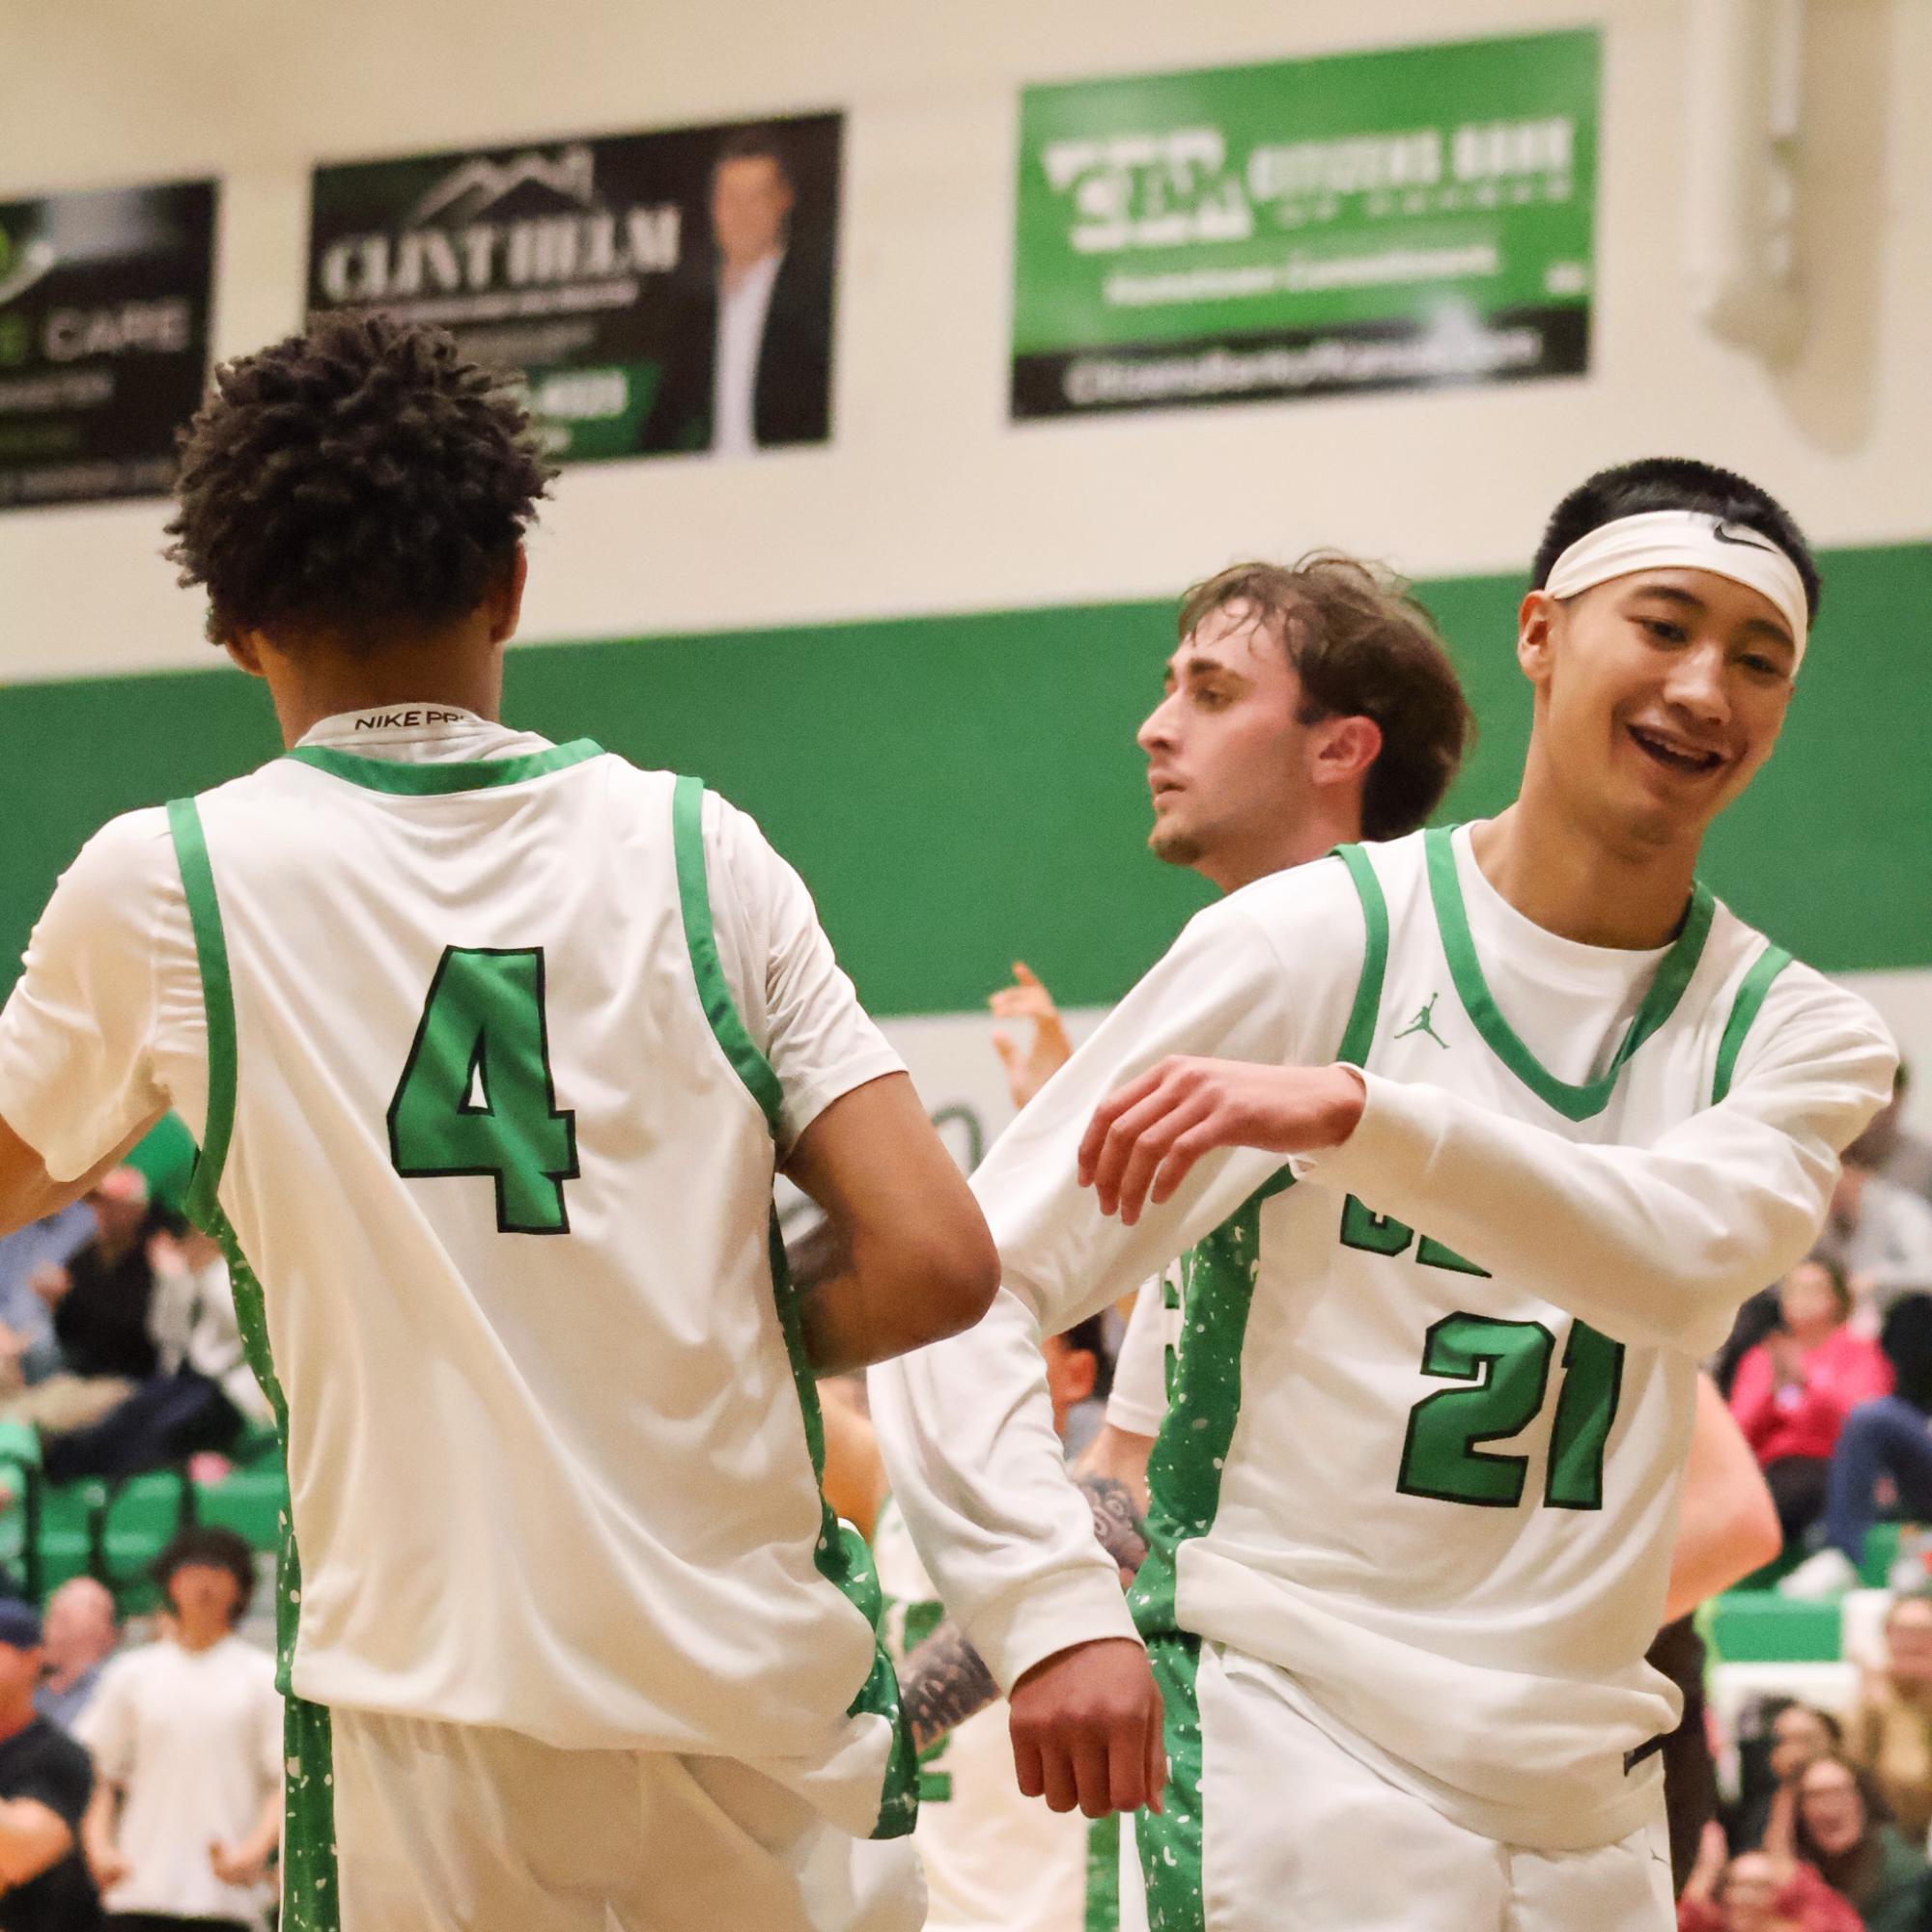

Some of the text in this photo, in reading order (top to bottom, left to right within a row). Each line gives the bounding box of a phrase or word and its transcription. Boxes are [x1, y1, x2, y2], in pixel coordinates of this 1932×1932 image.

[354, 711, 422, 730] NIKE
[386, 944, 581, 1235] 4
[1396, 1310, 1626, 1511] 21
